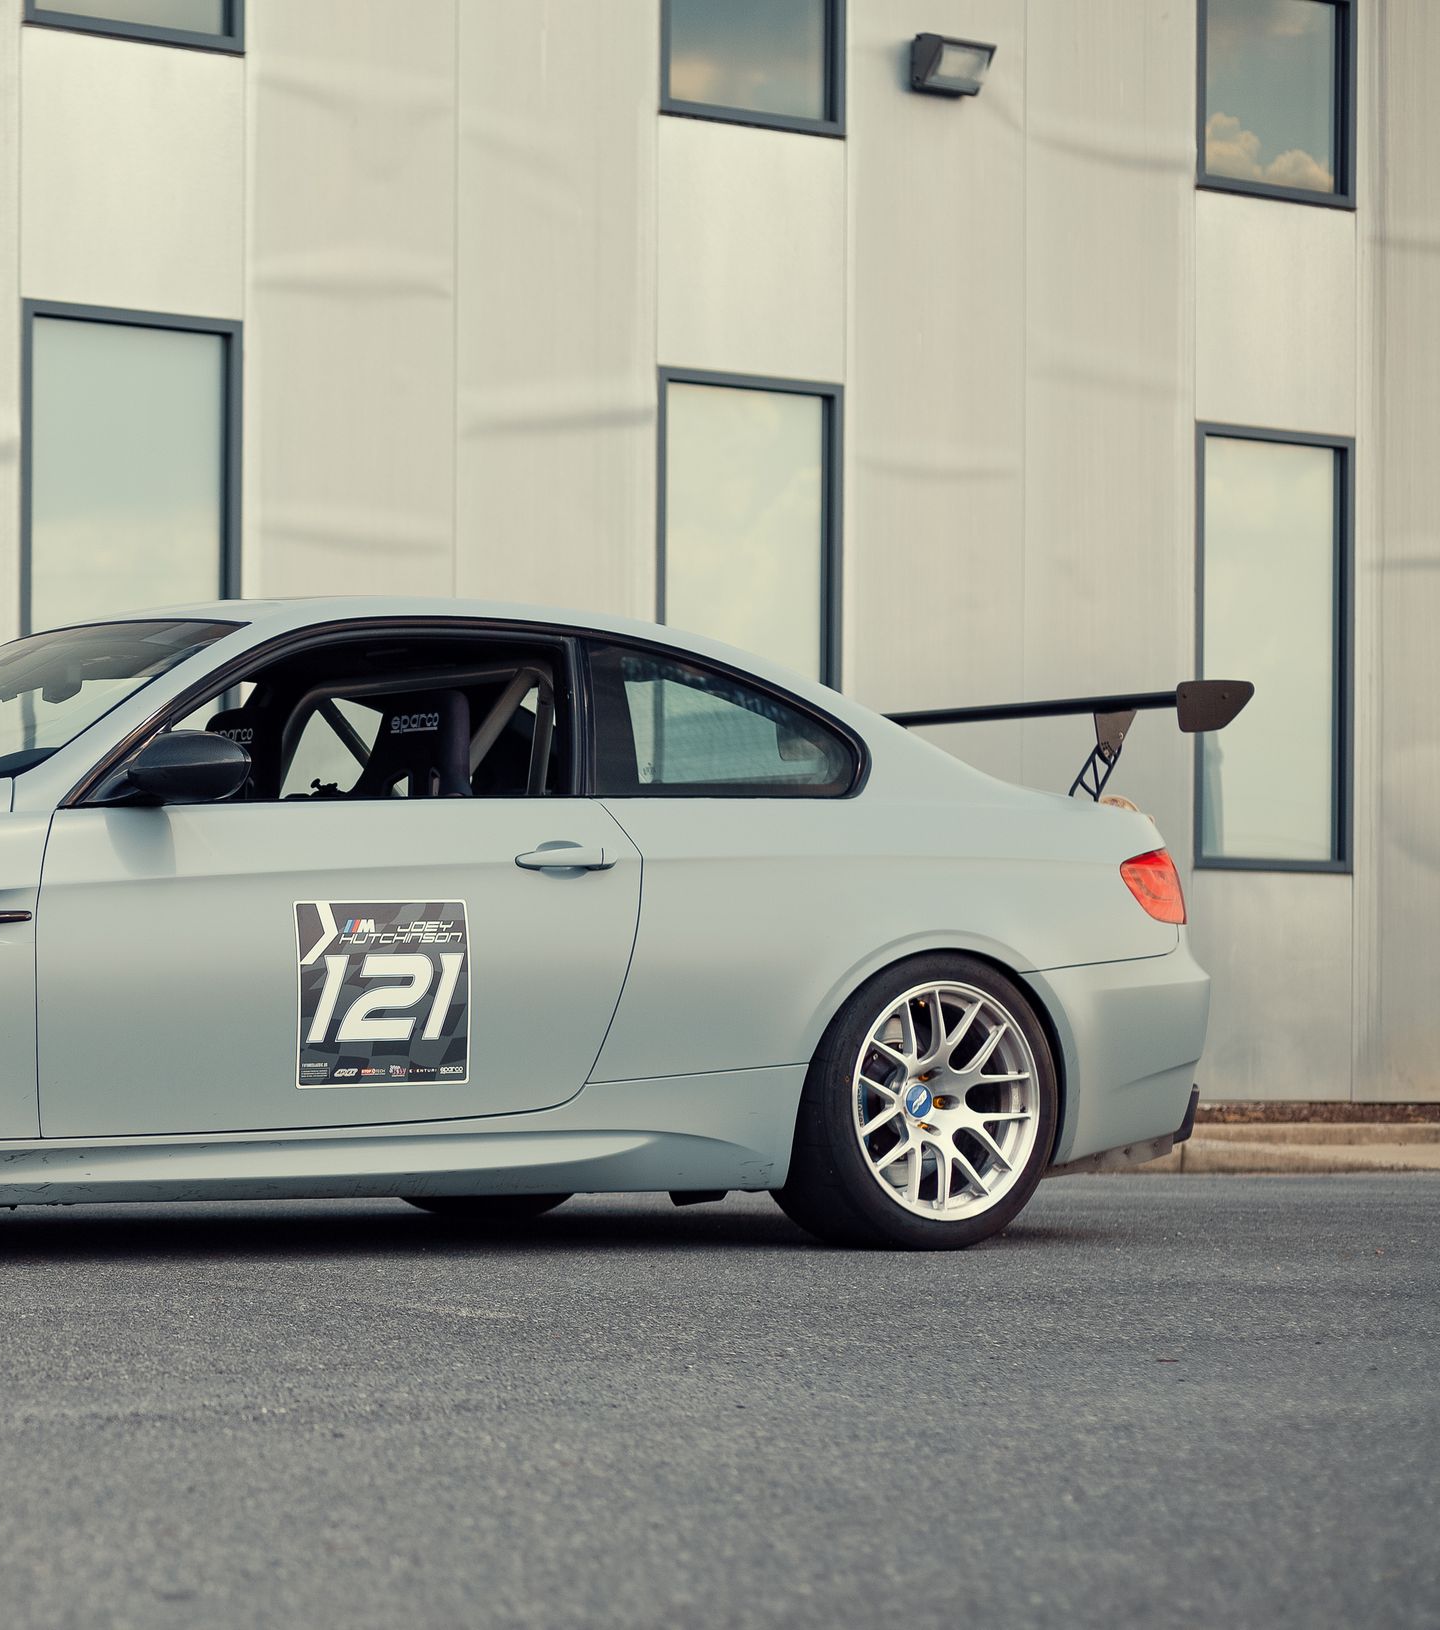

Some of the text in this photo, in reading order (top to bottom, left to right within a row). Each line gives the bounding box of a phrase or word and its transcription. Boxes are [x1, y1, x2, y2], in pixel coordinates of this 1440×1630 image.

[390, 712, 440, 734] sparco
[397, 921, 454, 932] JOEY
[339, 932, 463, 945] HUTCHINSON
[305, 952, 465, 1044] 121
